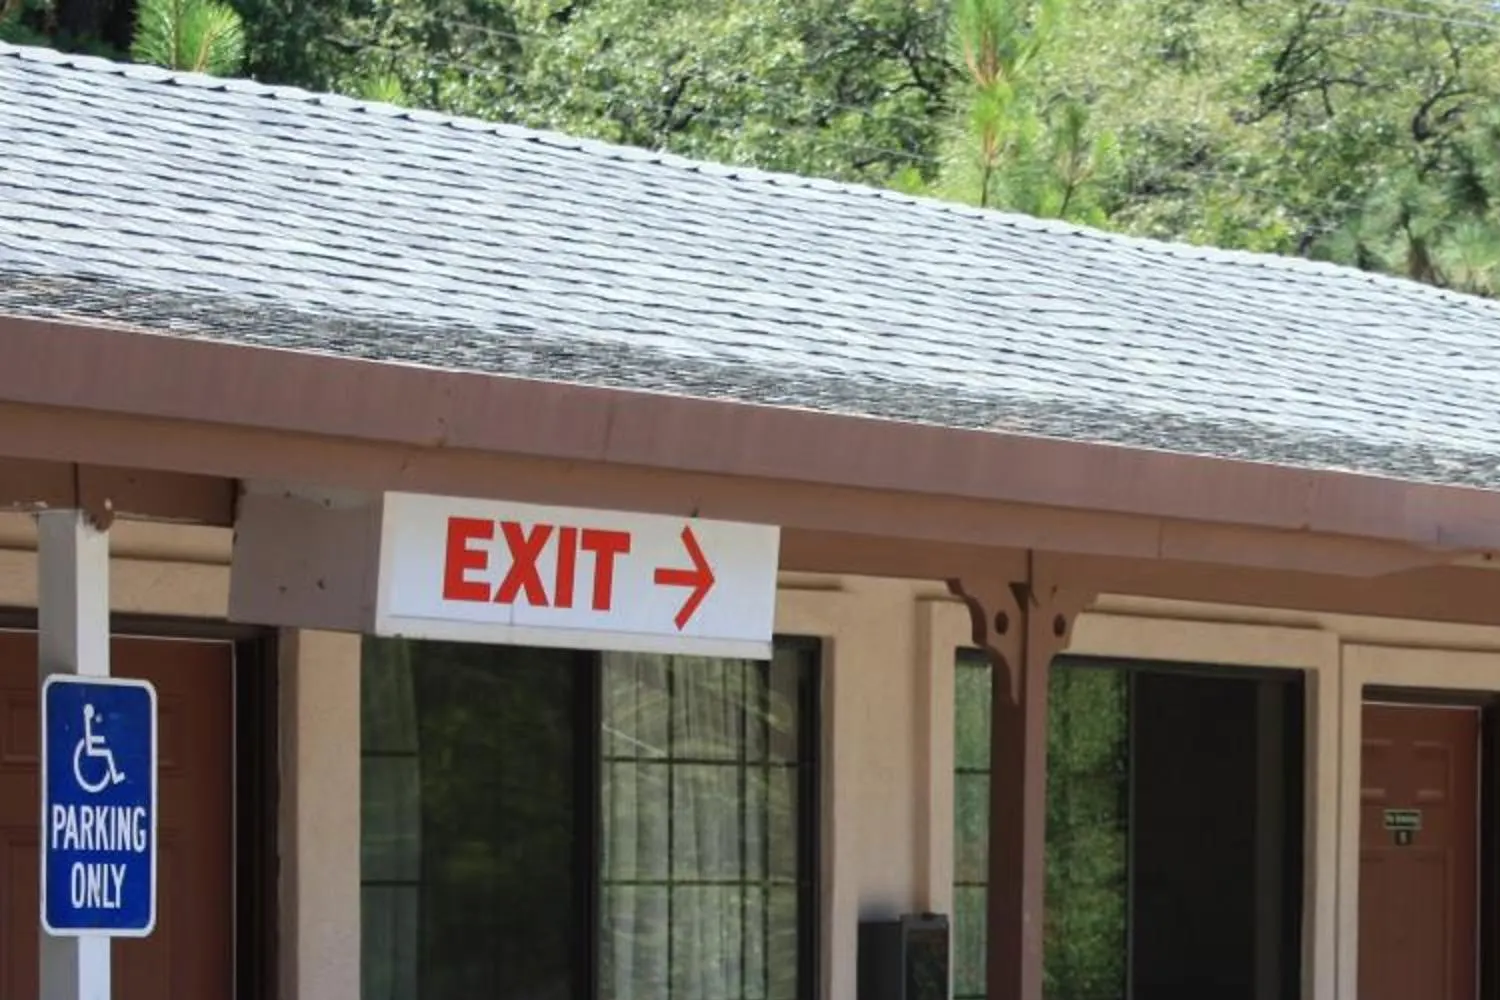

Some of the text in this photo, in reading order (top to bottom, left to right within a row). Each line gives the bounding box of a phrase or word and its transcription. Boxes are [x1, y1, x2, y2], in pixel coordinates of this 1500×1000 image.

[442, 517, 632, 611] EXIT
[52, 804, 147, 853] PARKING
[71, 862, 127, 908] ONLY
